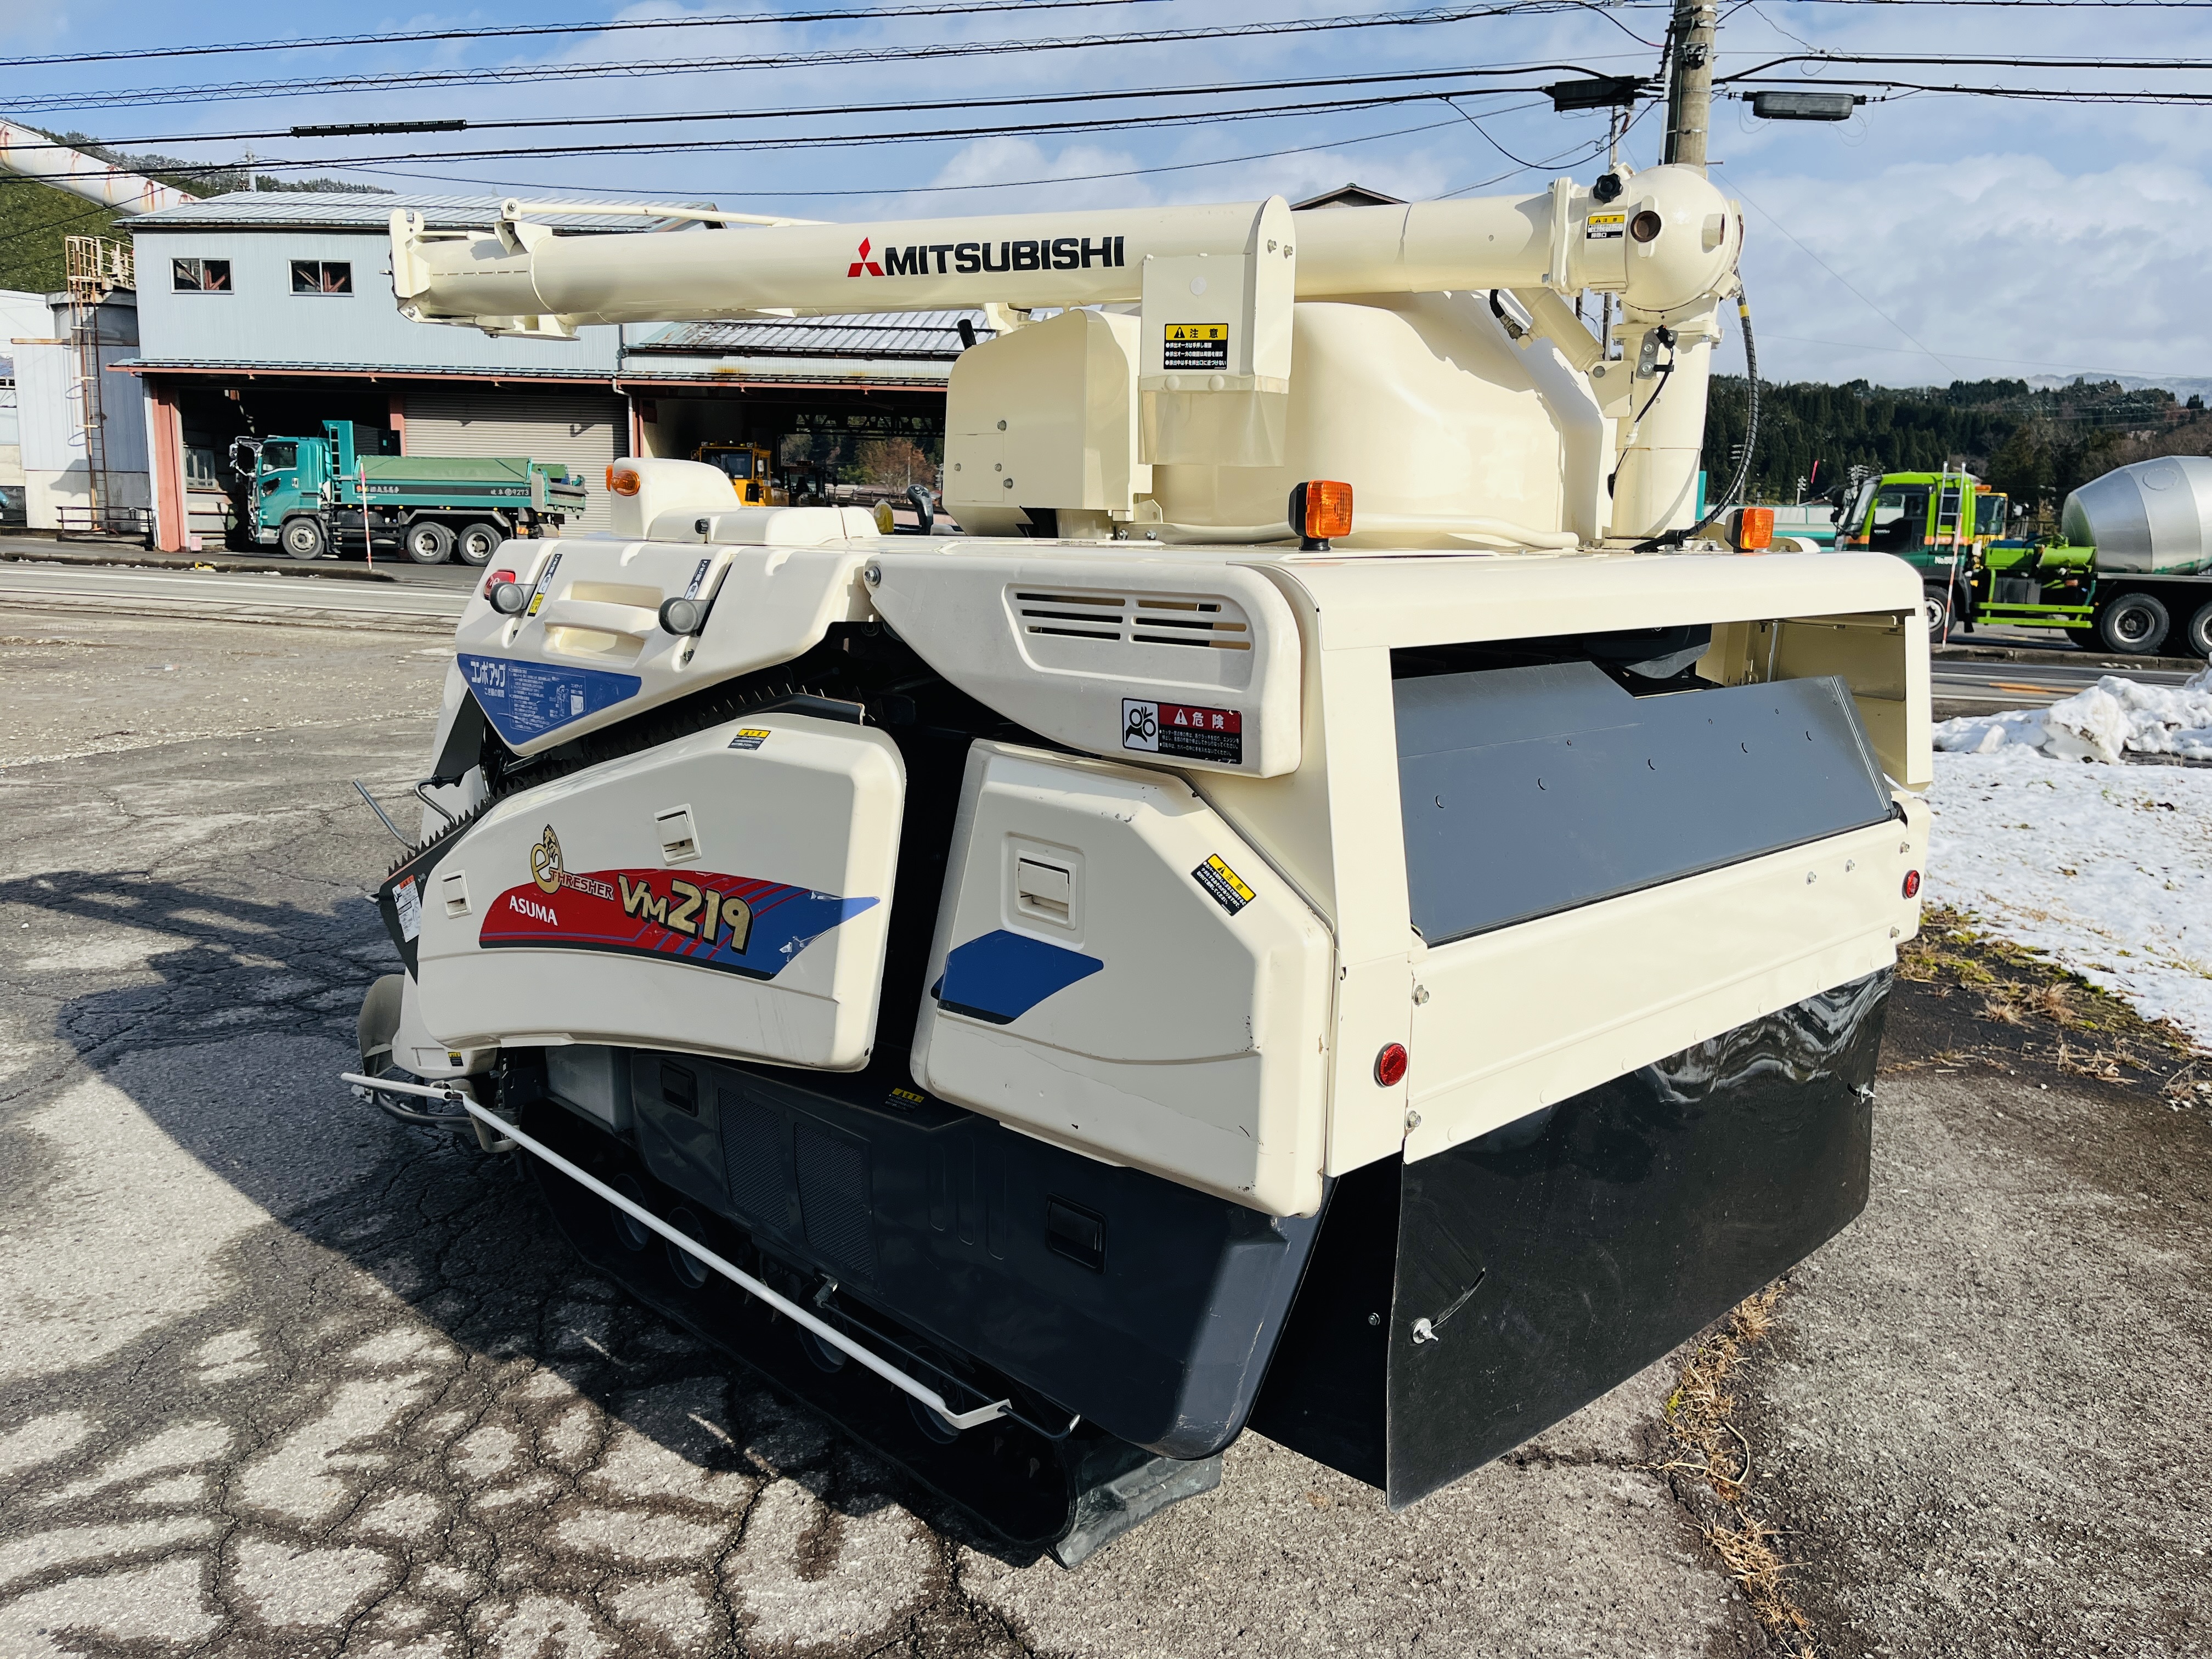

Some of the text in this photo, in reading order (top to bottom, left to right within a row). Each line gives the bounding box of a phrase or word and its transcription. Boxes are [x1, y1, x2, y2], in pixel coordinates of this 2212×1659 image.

[885, 236, 1125, 276] MITSUBISHI
[1189, 328, 1218, 338] 注意
[1192, 712, 1224, 730] 危険
[550, 868, 614, 901] THRESHER
[509, 895, 558, 926] ASUMA
